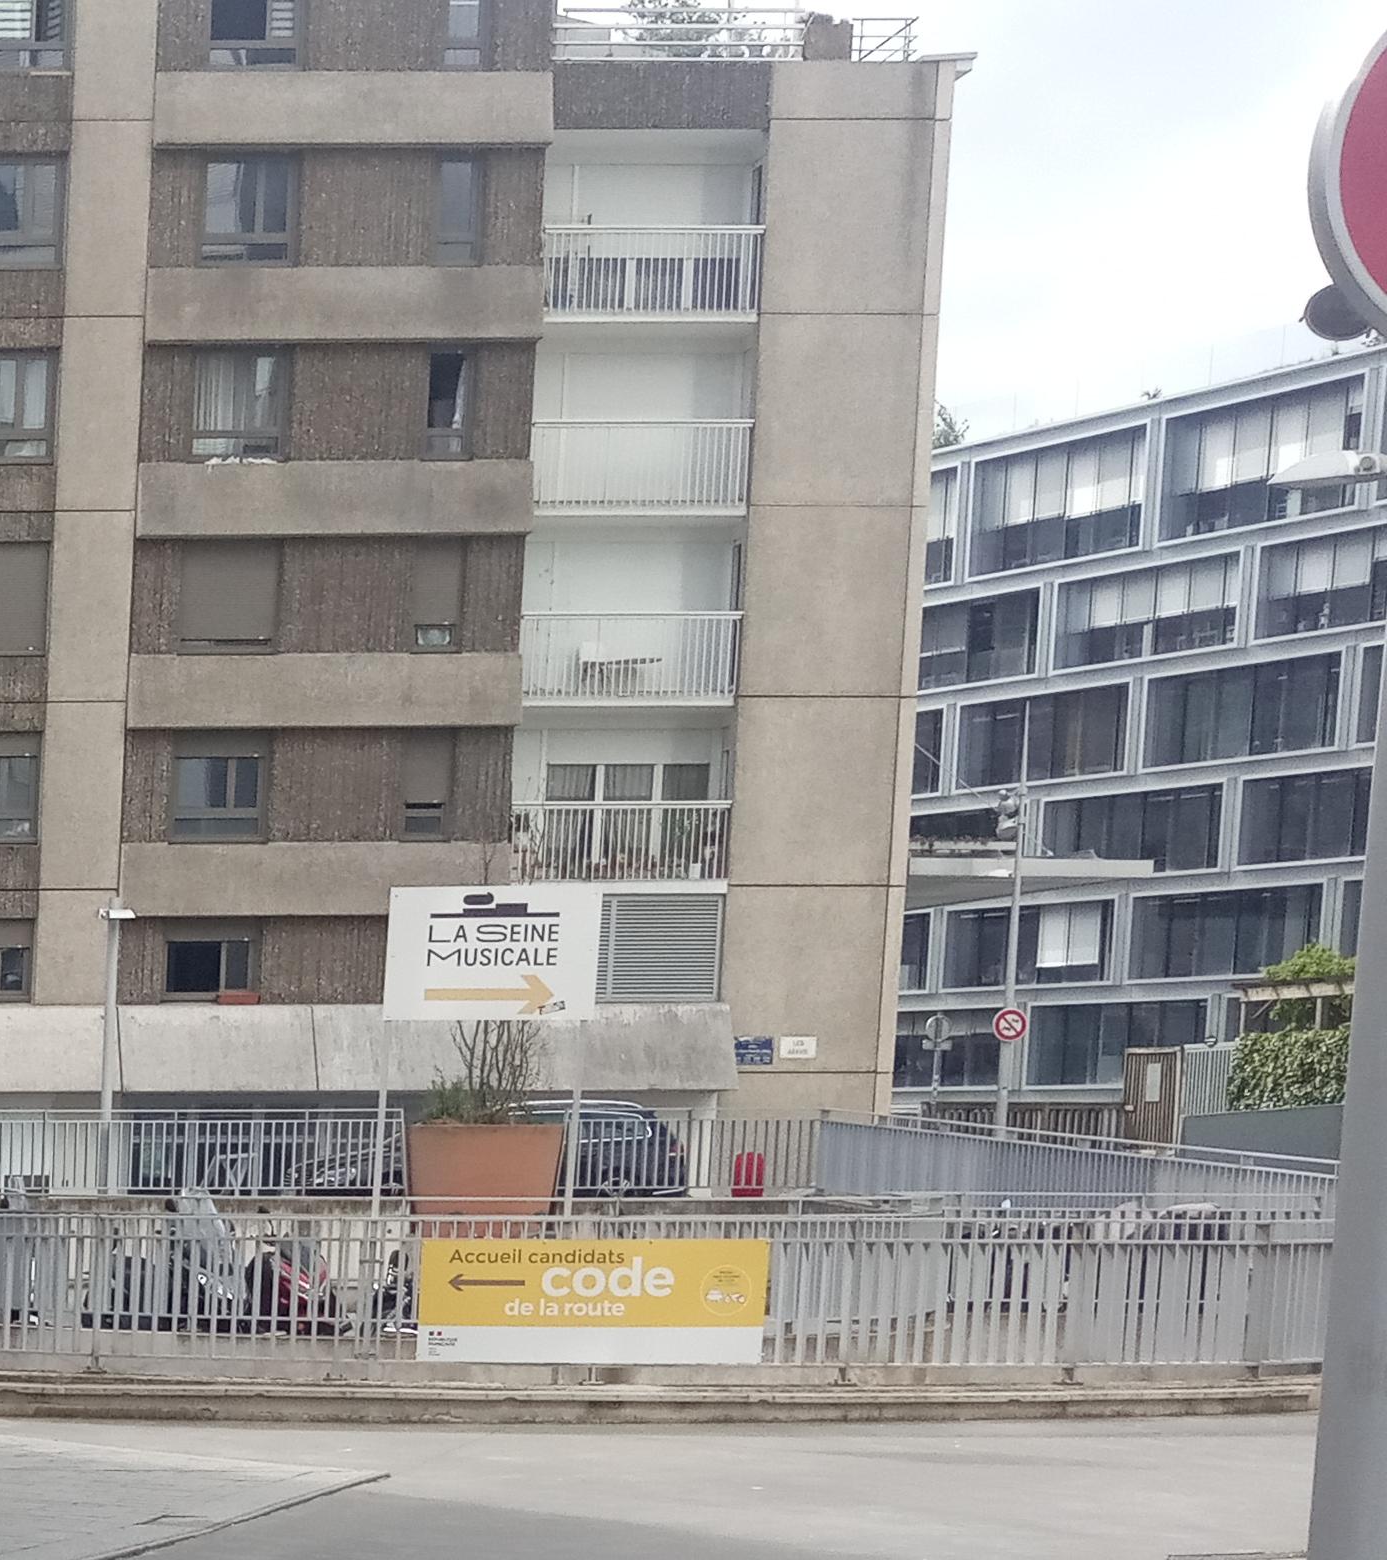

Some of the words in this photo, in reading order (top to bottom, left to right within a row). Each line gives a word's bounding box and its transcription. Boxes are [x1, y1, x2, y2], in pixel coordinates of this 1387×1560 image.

[428, 923, 468, 943] LA
[475, 923, 560, 943] SEINE
[426, 947, 559, 967] MUSICALE
[449, 1249, 522, 1264] Accueil
[528, 1249, 625, 1264] candidats
[541, 1256, 675, 1297] code
[504, 1298, 534, 1316] de
[539, 1298, 559, 1316] la
[564, 1299, 625, 1316] route
